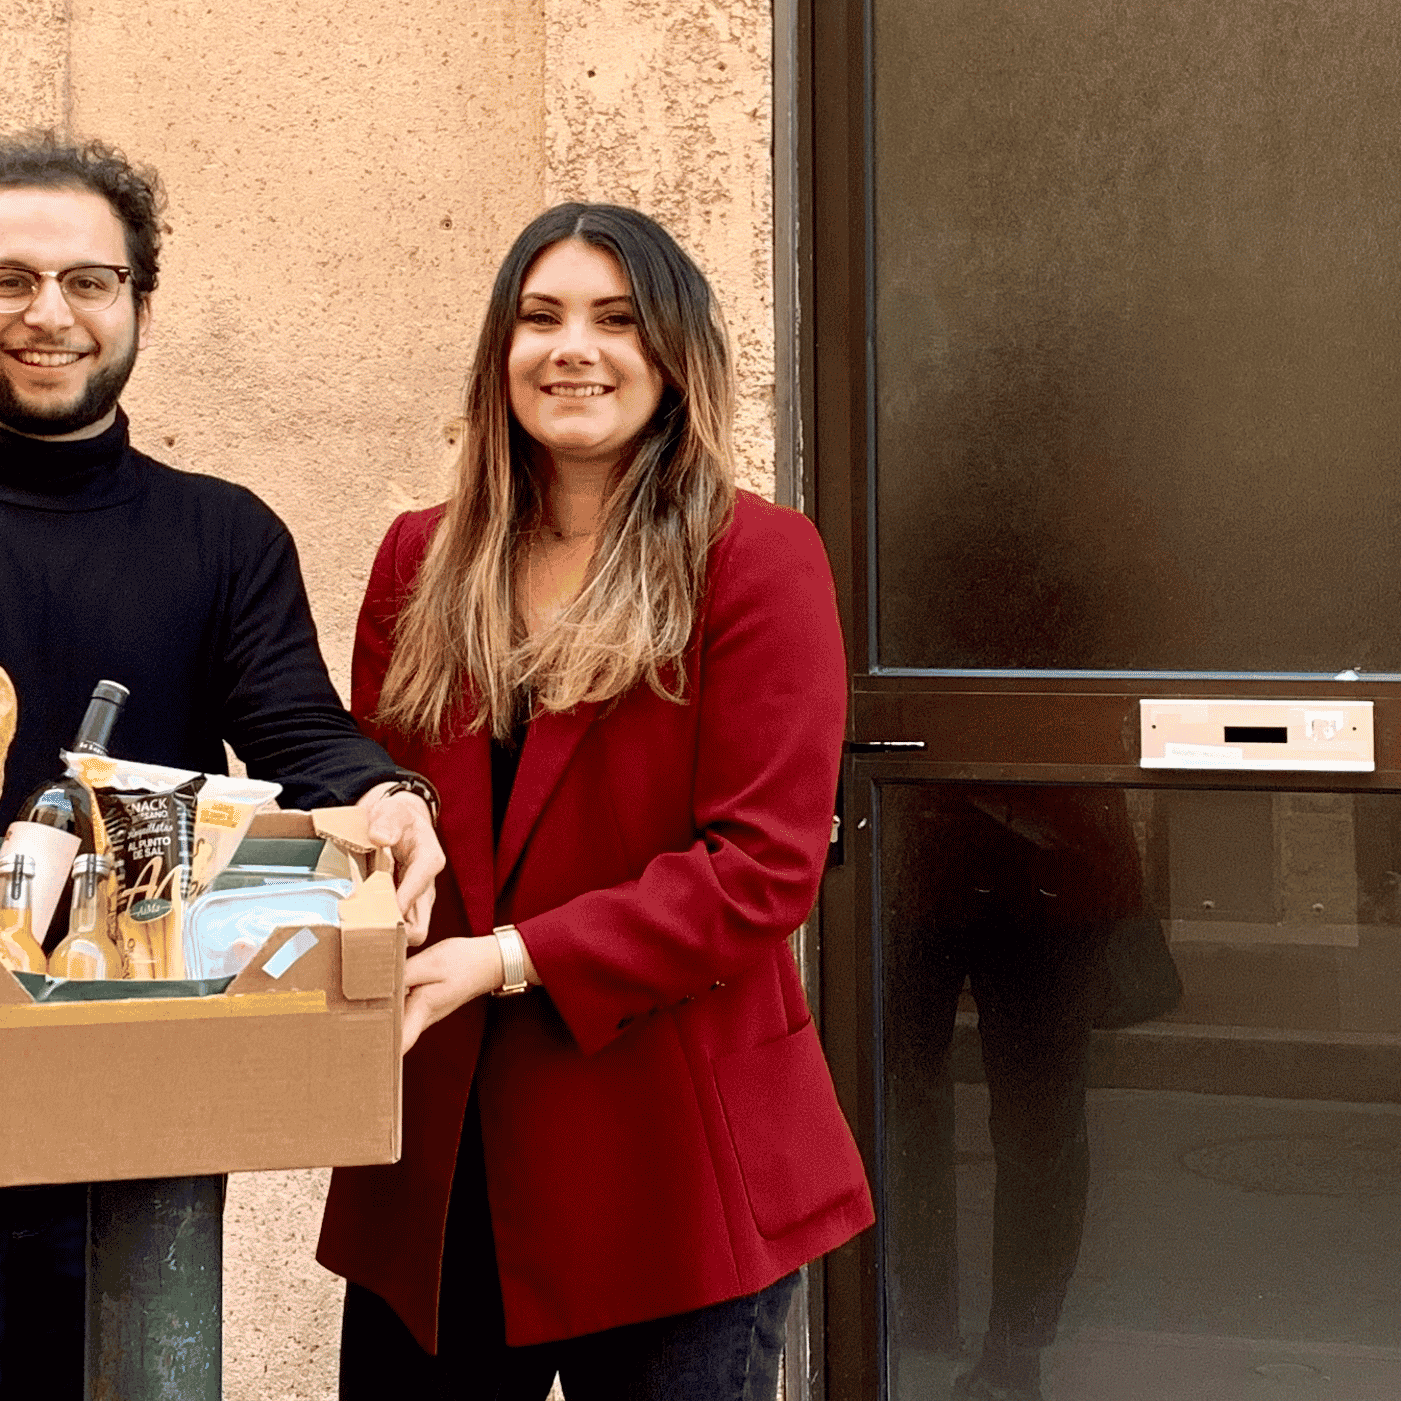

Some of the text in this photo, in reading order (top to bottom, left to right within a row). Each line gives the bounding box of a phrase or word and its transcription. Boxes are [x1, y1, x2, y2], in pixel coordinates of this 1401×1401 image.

[138, 836, 171, 848] PUNTO
[133, 847, 164, 860] DE SAL
